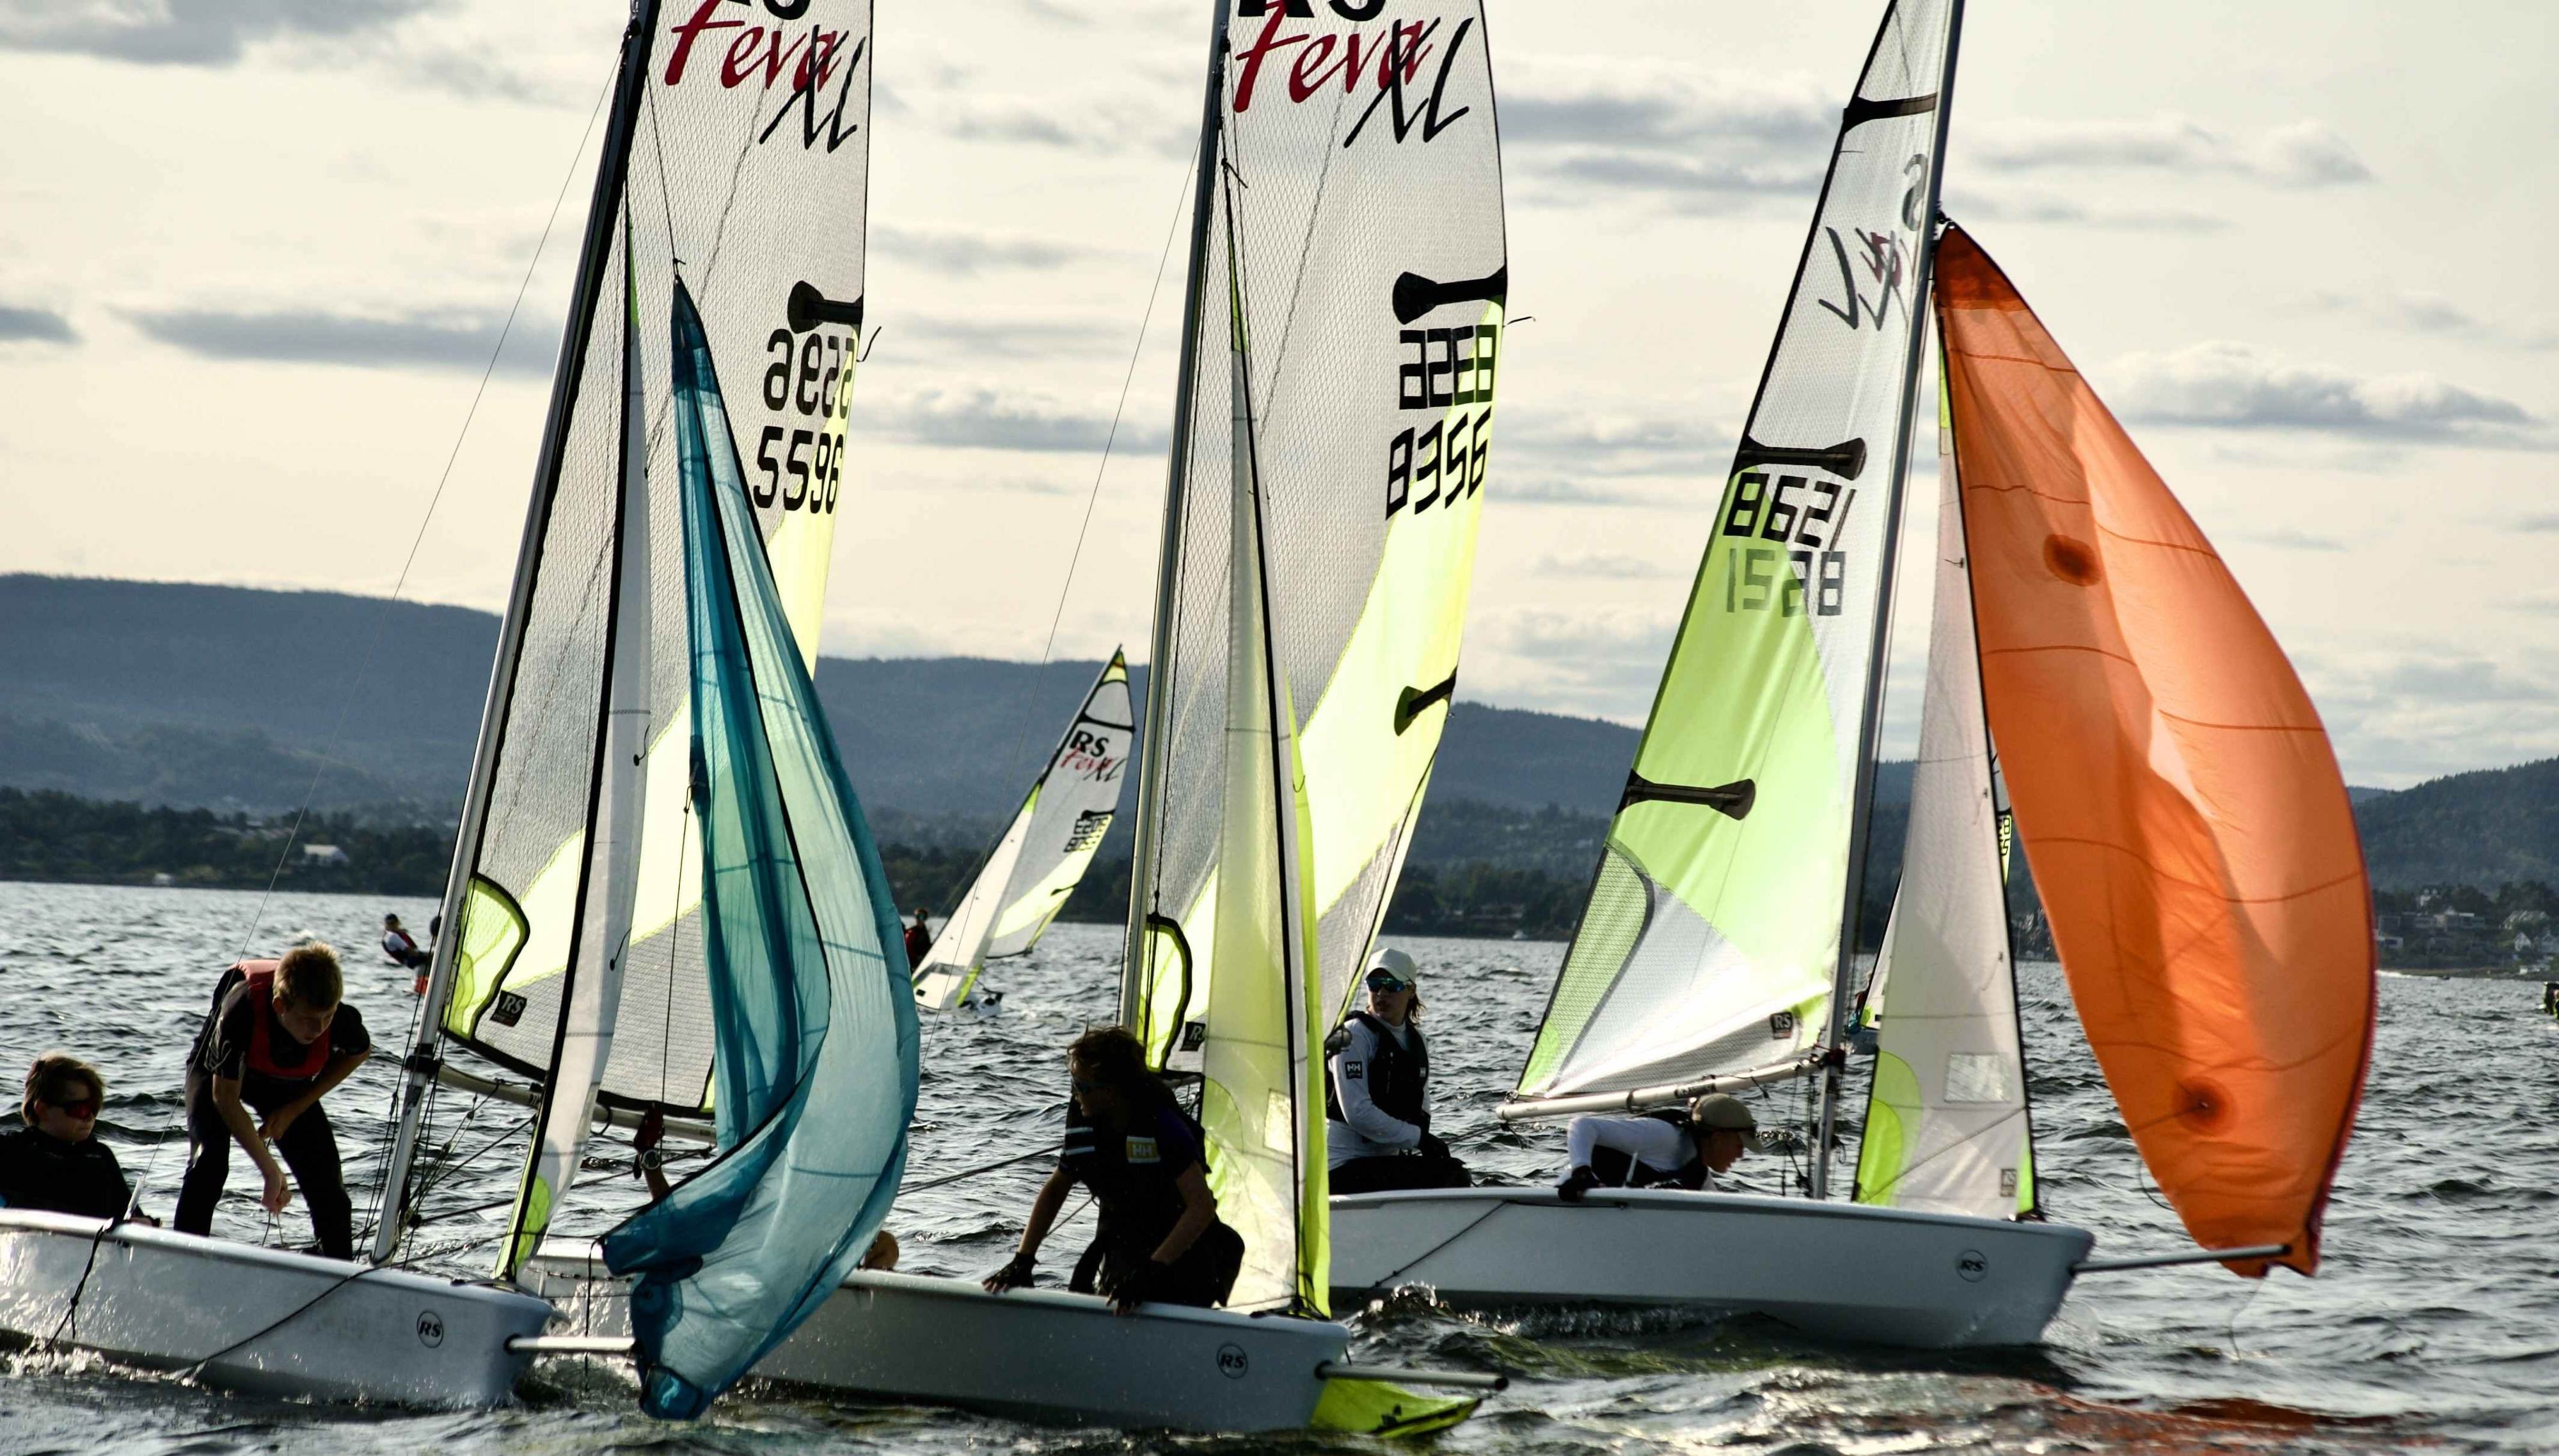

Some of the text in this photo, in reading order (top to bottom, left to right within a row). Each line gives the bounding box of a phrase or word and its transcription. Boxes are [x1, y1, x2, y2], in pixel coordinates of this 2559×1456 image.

[1233, 0, 1433, 113] Feva
[759, 24, 867, 154] XL
[1343, 17, 1474, 148] XL
[753, 425, 844, 514] 5596
[1385, 405, 1492, 521] 8356
[1723, 472, 1857, 551] 8621
[1069, 730, 1110, 757] RS
[501, 994, 525, 1014] RS
[1774, 1014, 1791, 1029] RS
[1132, 1143, 1153, 1157] HH
[1960, 1258, 1986, 1272] RS
[419, 1320, 441, 1338] RS
[1220, 1353, 1244, 1368] RS
